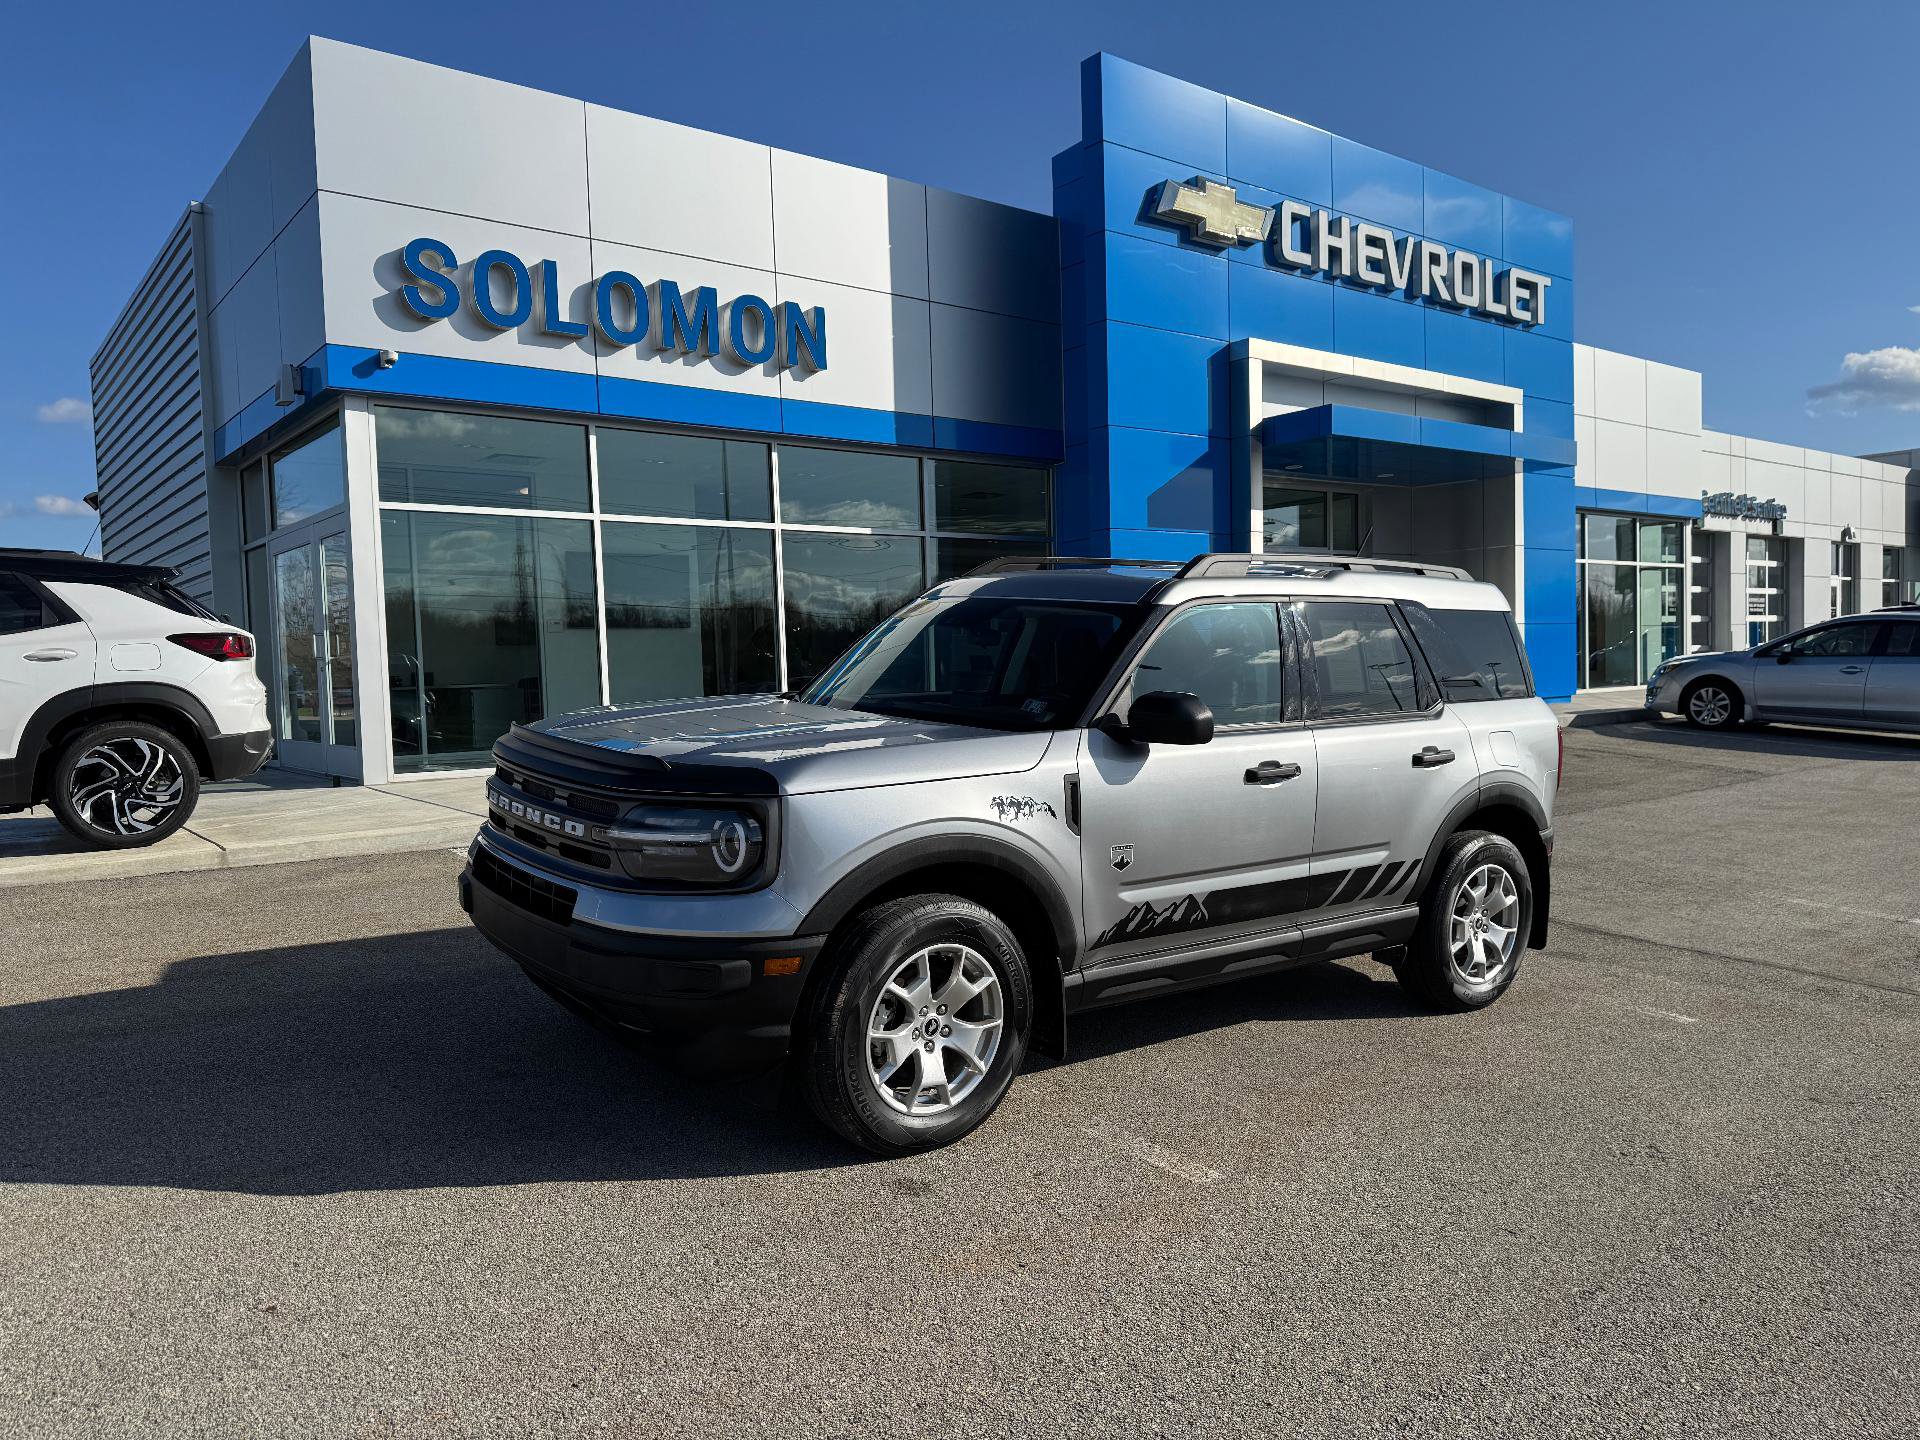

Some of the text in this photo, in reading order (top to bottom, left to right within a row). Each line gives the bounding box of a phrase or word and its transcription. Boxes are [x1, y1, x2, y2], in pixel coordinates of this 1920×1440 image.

[400, 237, 828, 372] SOLOMON
[1279, 199, 1552, 326] CHEVROLET
[487, 788, 585, 837] BRONCO
